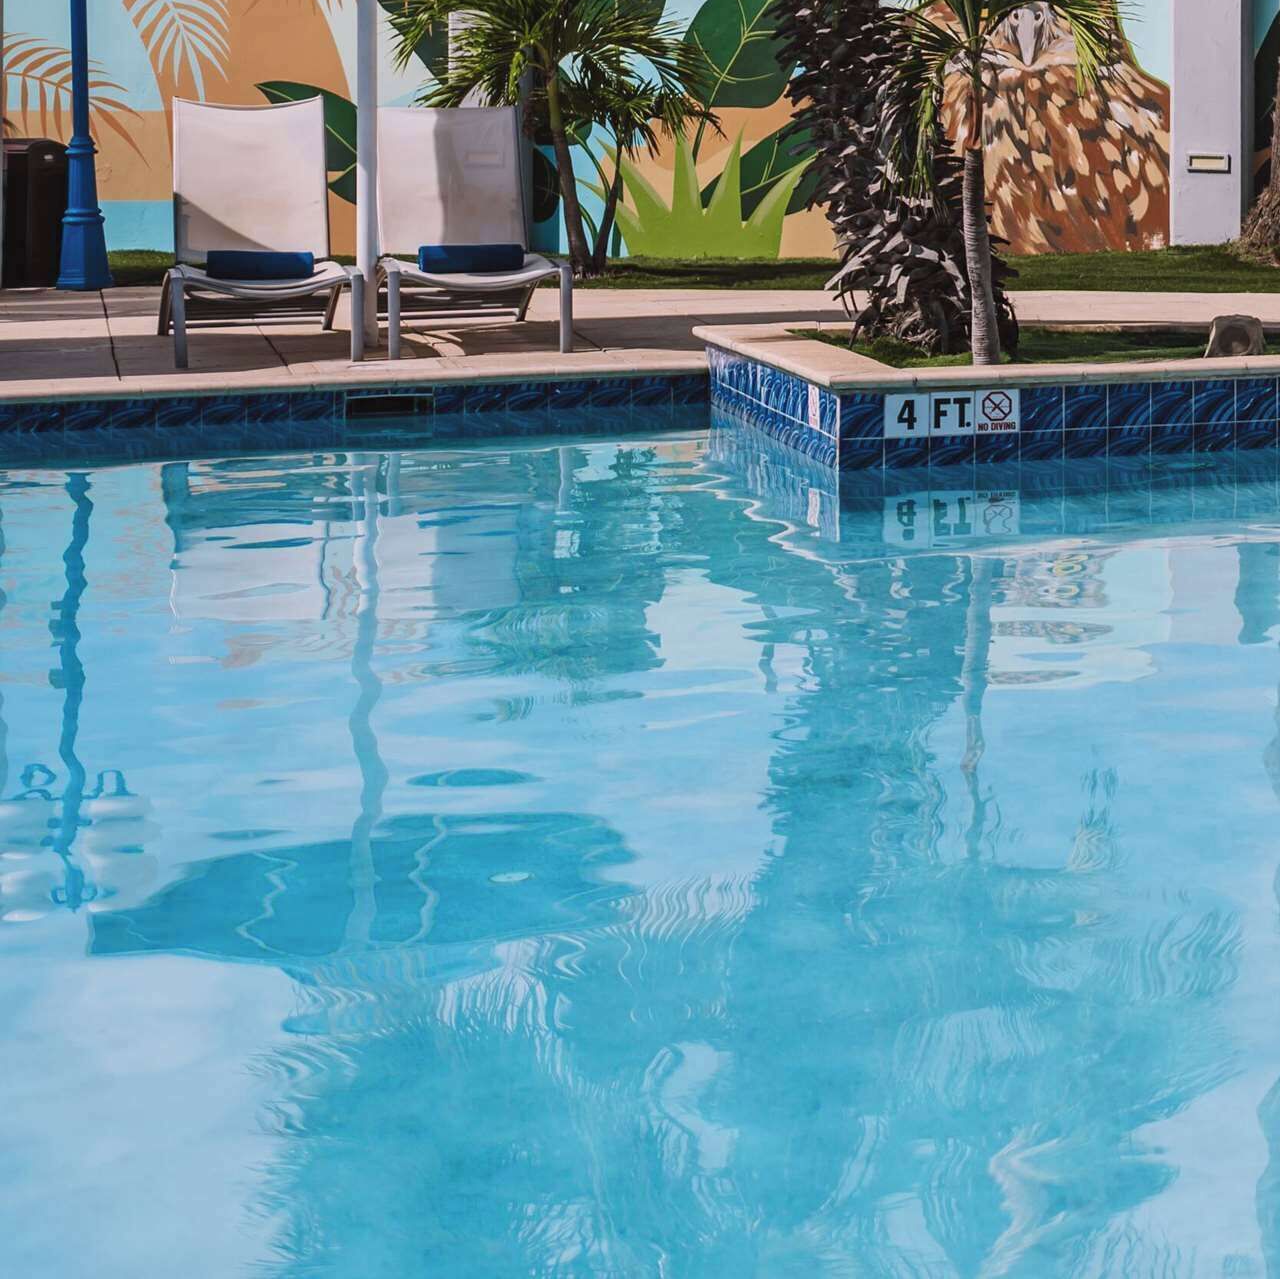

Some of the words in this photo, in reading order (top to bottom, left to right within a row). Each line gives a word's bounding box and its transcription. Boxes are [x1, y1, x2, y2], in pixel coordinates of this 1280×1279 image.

[897, 399, 917, 430] 4
[934, 397, 971, 429] FT.
[977, 423, 989, 431] NO
[991, 421, 1016, 431] DIVING
